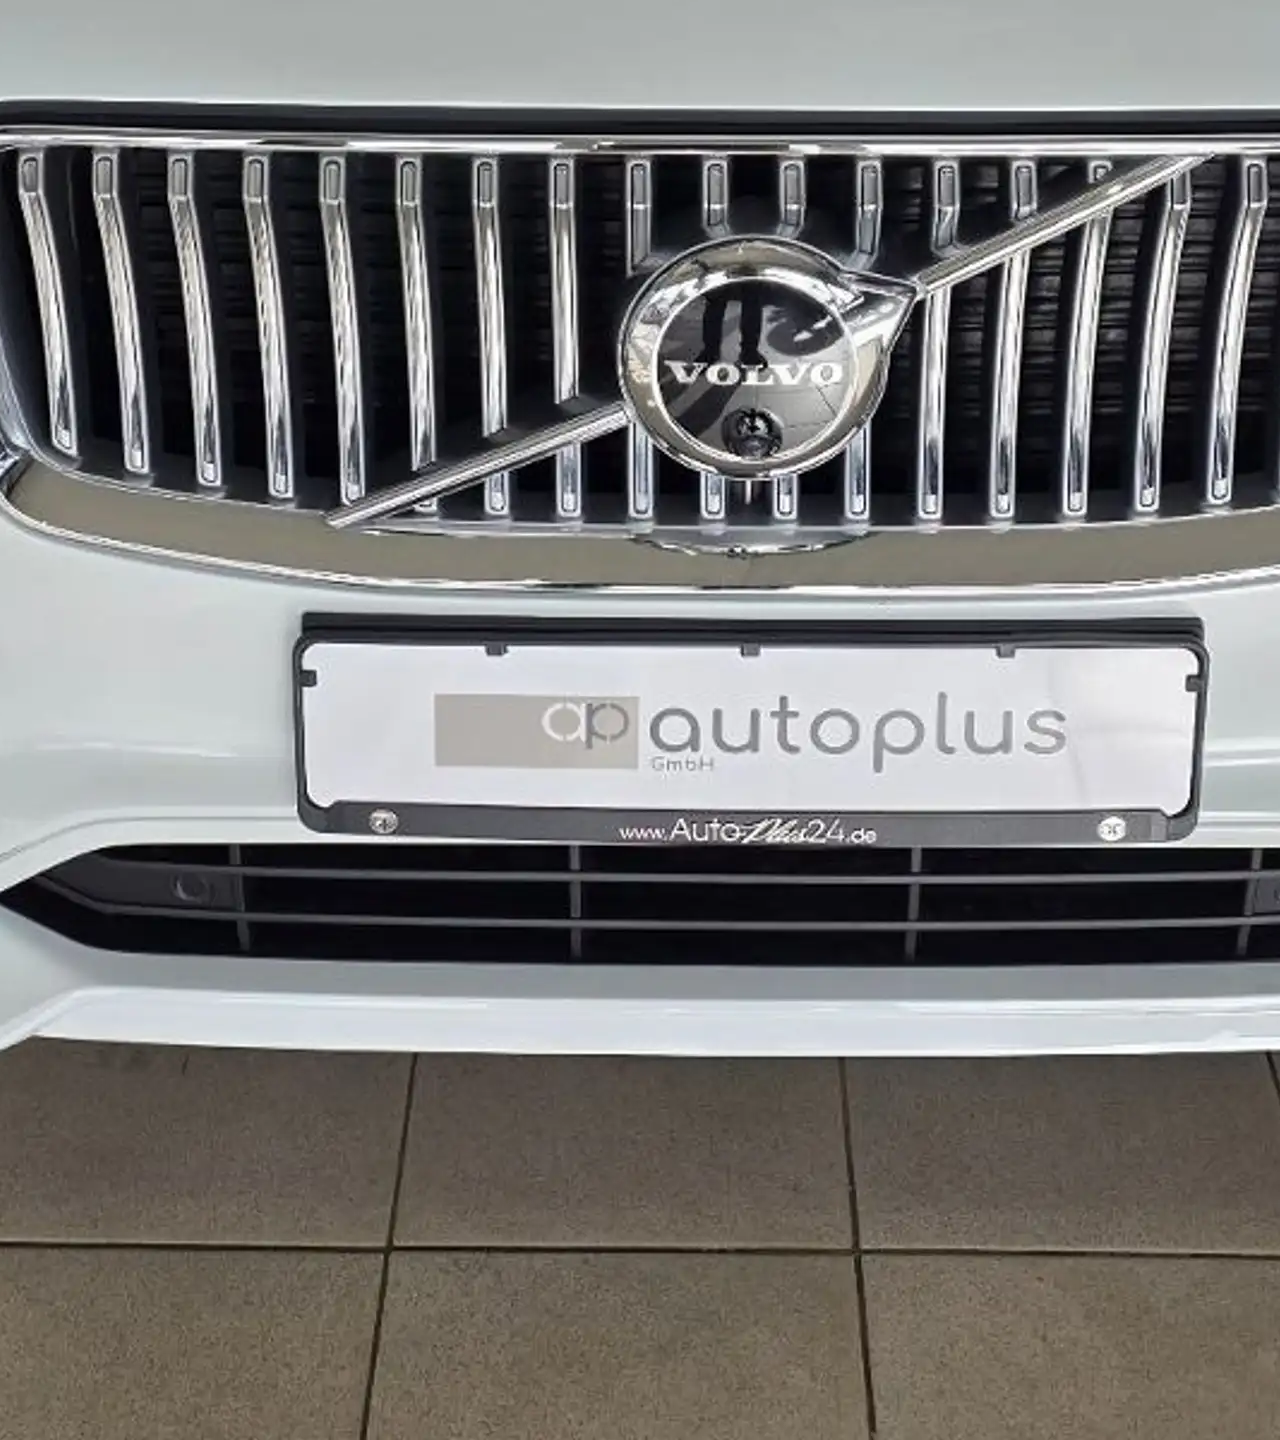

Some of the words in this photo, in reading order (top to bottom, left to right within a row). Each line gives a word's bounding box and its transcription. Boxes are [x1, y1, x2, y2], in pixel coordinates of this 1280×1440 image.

[664, 359, 842, 386] VOLVO
[649, 691, 1068, 774] autoplus
[651, 755, 714, 772] GmbH
